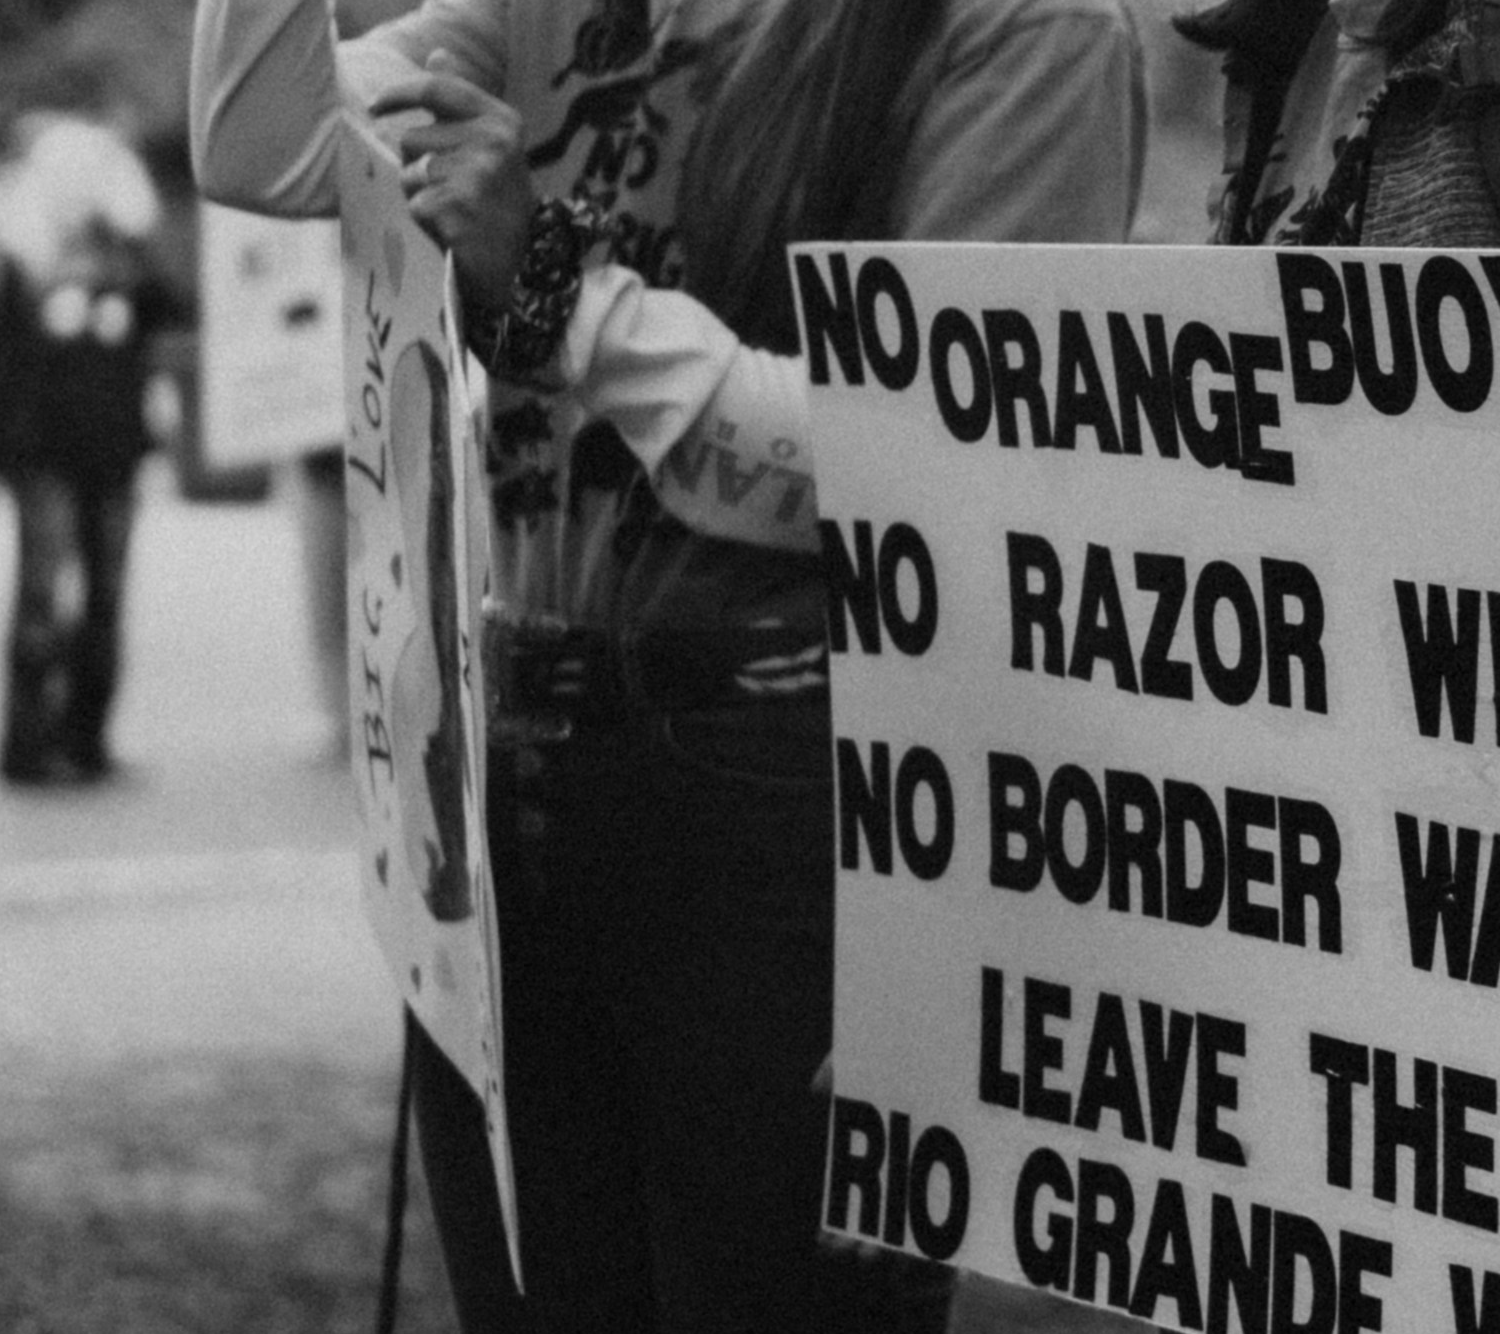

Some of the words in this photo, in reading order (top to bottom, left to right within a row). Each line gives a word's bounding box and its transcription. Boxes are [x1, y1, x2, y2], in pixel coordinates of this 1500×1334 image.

[794, 252, 920, 392] NO
[929, 307, 1297, 486] ORANGE
[818, 519, 939, 657] NO
[1006, 531, 1328, 715] RAZOR
[834, 737, 955, 880] NO
[987, 750, 1343, 955] BORDER
[826, 1095, 971, 1260] RIO
[977, 965, 1248, 1169] LEAVE
[1309, 1032, 1500, 1234] THE
